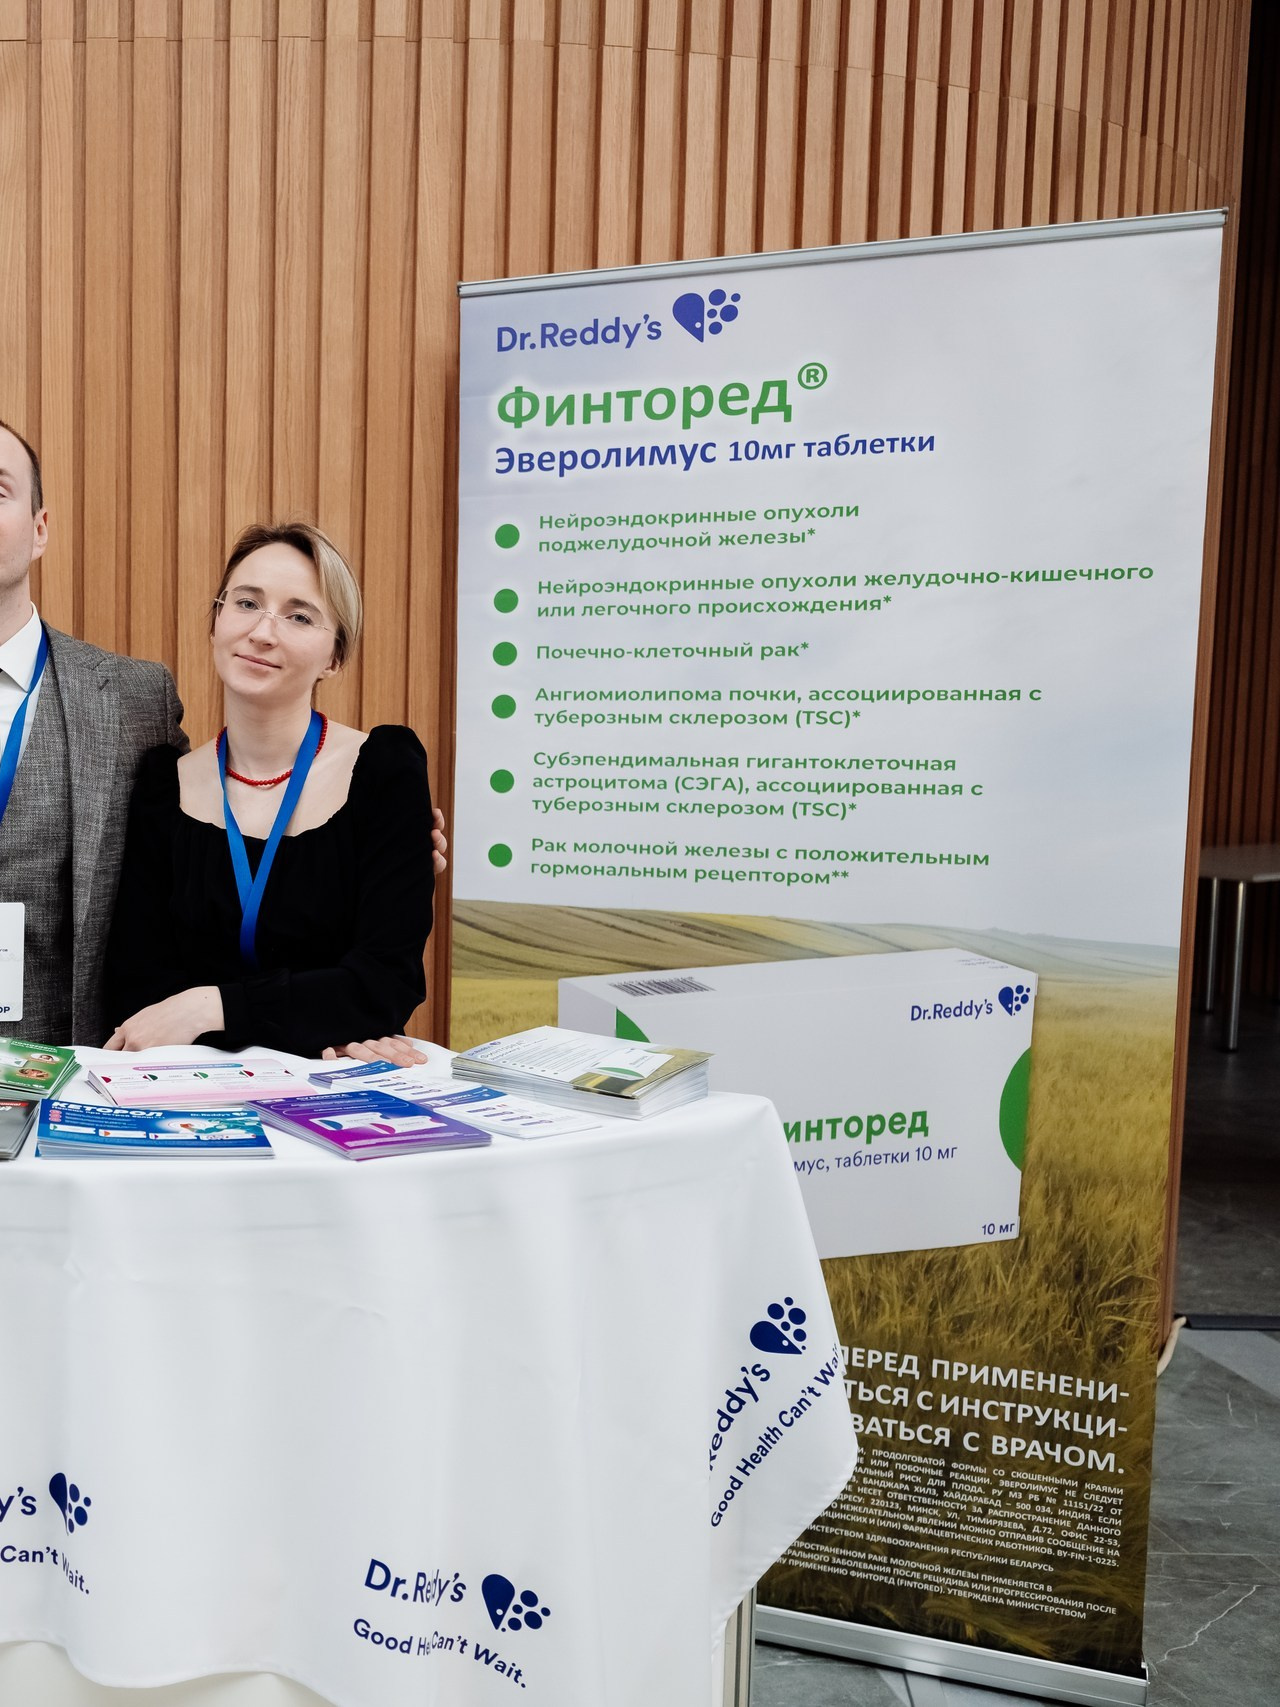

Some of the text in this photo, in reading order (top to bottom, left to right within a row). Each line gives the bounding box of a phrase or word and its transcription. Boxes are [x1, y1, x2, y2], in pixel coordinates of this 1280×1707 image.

[496, 313, 662, 353] Dr.Reddy's
[496, 361, 829, 430] Финторед®
[494, 432, 935, 478] Эверолимус 10мг таблетки
[539, 504, 859, 532] Нейроэндокринные опухоли
[538, 530, 711, 554] поджелудочной
[537, 566, 1154, 598] Нейроэндокринные опухоли желудочно-кишечного
[536, 605, 575, 618] или
[580, 602, 691, 617] легочного
[536, 641, 753, 660] Почечно-клеточный
[534, 687, 1042, 705] Ангиомиолипома почки, ассоциированная с
[533, 708, 662, 728] туберозным
[668, 712, 788, 729] склерозом
[532, 750, 956, 772] Субэпендимальная гигантоклеточная
[532, 775, 983, 798] астроцитома (СЭГА), ассоциированная с
[531, 795, 660, 815] туберозным
[665, 801, 784, 819] склерозом
[531, 837, 989, 866] Рак молочной железы с положительным
[530, 862, 687, 880] гормональным
[910, 998, 994, 1022] Dr.Reddy's
[52, 1101, 164, 1118] КЕТОРОЛ
[784, 1108, 930, 1146] инторед
[834, 1146, 958, 1170] таблетки 10 мг
[981, 1222, 1016, 1237] 10 мг
[931, 1357, 1130, 1404] ПРИМЕНЕНИ-
[916, 1389, 934, 1411] С
[940, 1392, 1128, 1440] ИНСТРУКЦИ-
[710, 1385, 822, 1528] Good Health Can't
[962, 1430, 980, 1452] С
[991, 1434, 1124, 1475] ВРАЧОМ.
[865, 1532, 1054, 1573] ЗДРАВООХРАНЕНИЯ РЕСПУБЛИКИ БЕЛАРУСЬ
[901, 1522, 1120, 1568] ФАРМАЦЕВТИЧЕСКИХ РАБОТНИКОВ. BY-FIN-1-0225.
[0, 1545, 59, 1566] Can't
[60, 1553, 91, 1595] Wait.
[848, 1569, 946, 1595] ФИНТОРЕД (FINTORED).
[353, 1618, 414, 1655] Good
[430, 1630, 469, 1655] Can't
[473, 1642, 527, 1689] Wait.
